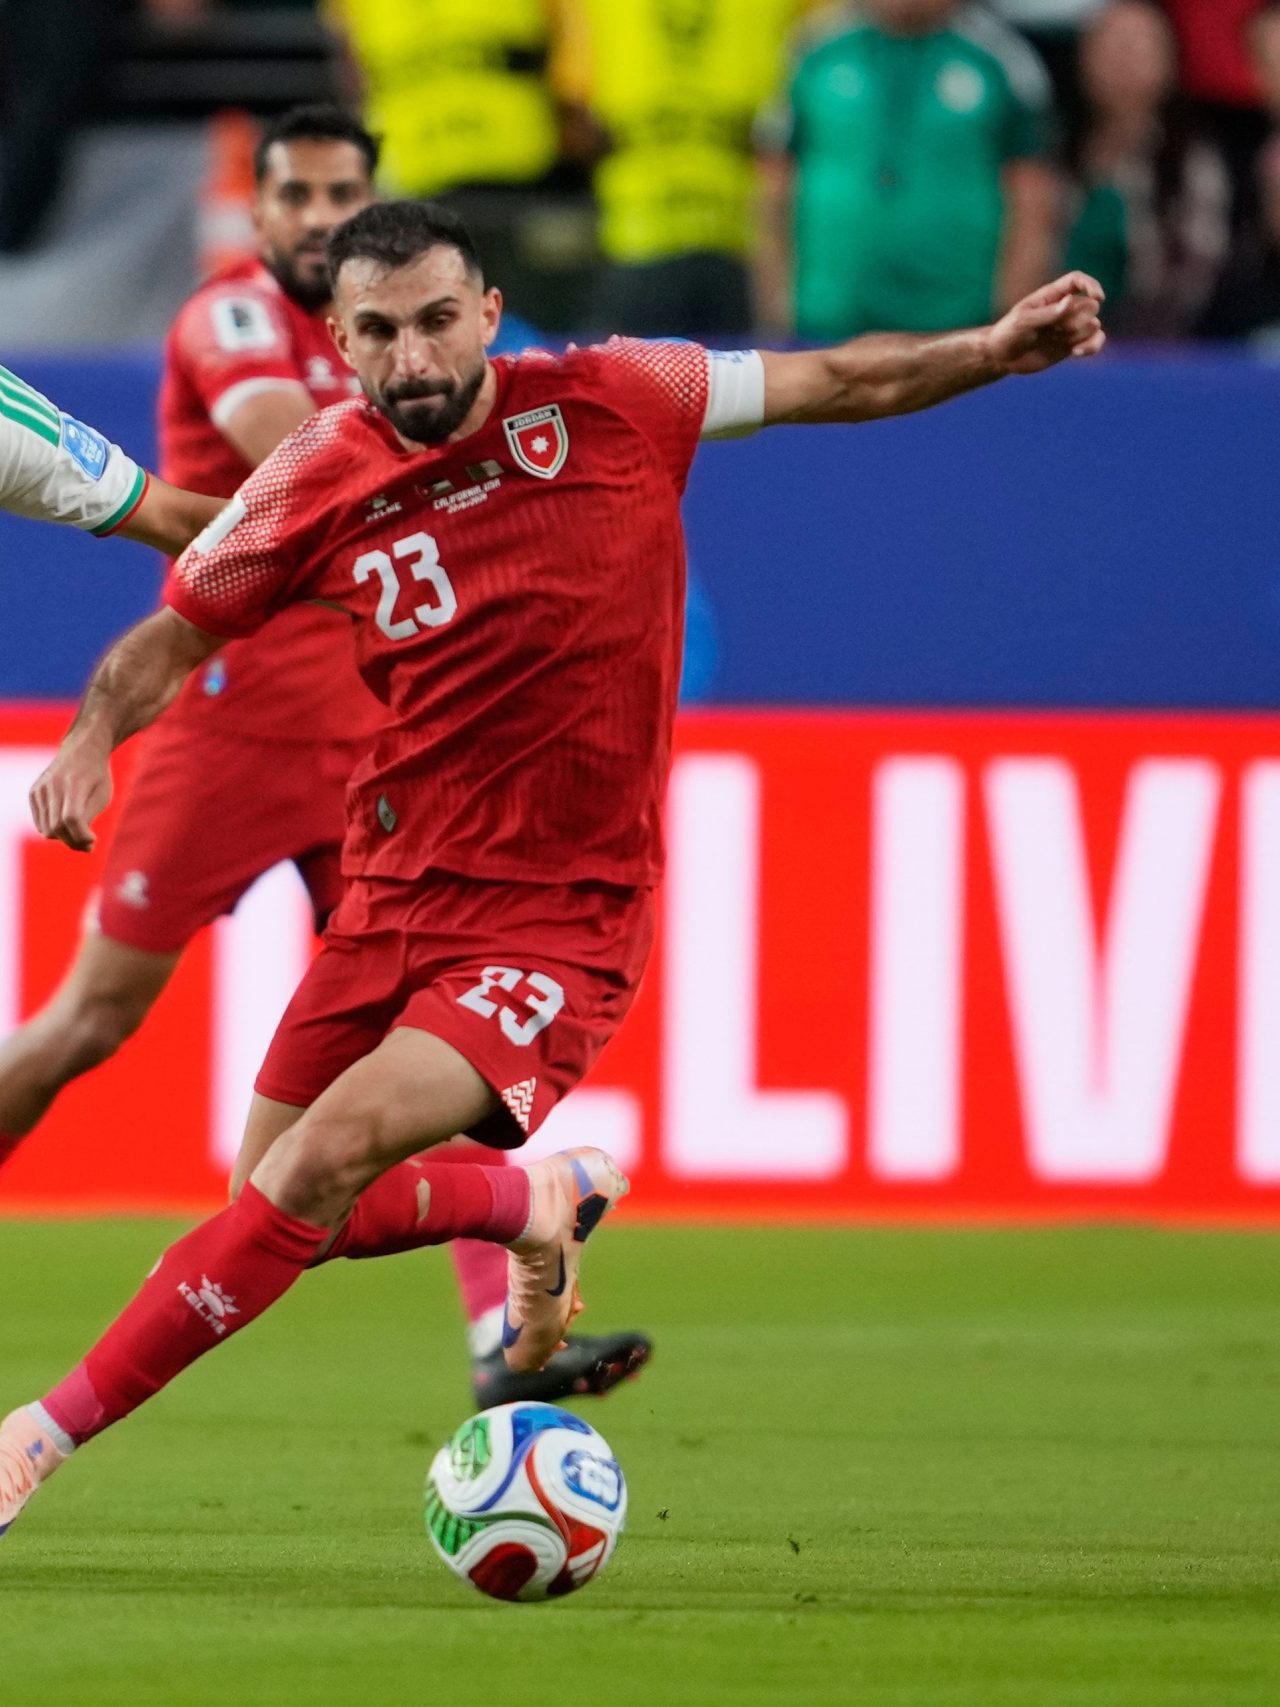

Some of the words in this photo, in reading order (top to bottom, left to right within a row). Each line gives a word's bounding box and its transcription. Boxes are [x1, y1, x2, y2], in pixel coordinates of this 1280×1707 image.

[513, 409, 553, 427] JORDAN
[353, 531, 458, 641] 23
[456, 965, 565, 1046] 23
